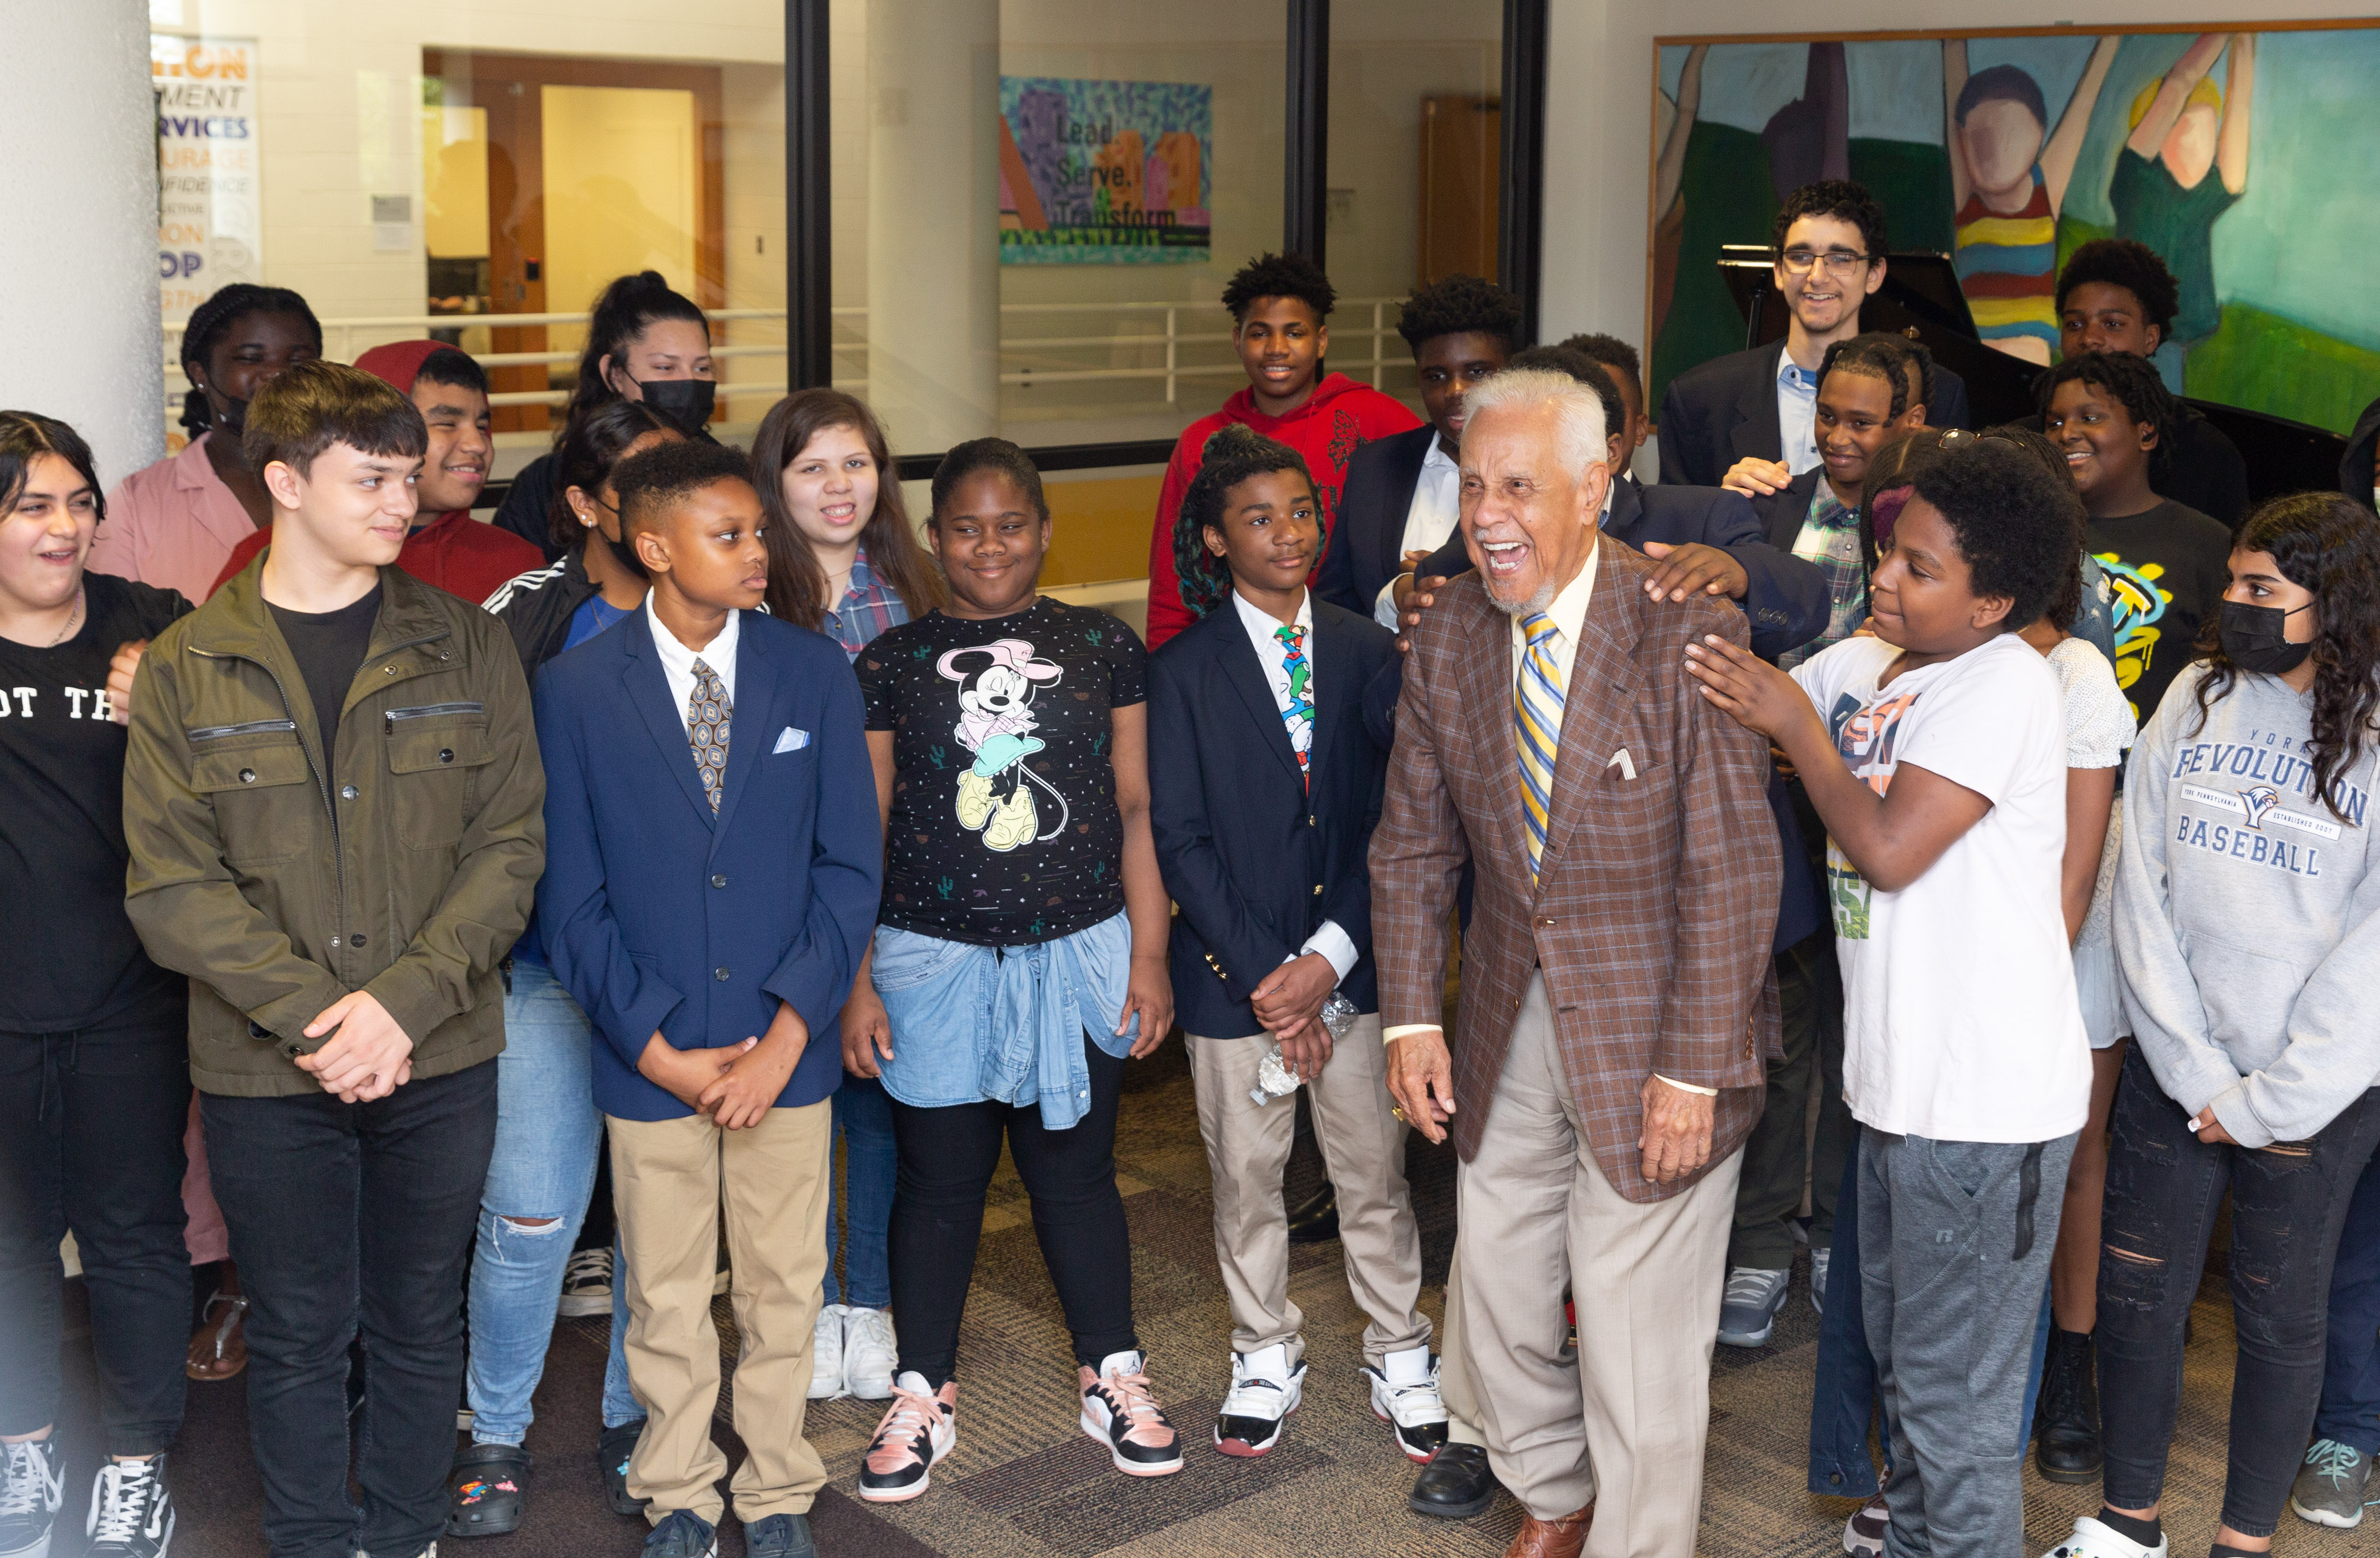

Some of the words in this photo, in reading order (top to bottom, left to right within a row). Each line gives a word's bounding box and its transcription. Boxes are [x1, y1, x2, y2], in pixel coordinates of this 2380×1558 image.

[2170, 743, 2370, 829] REVOLUTON
[2196, 792, 2237, 808] PENNSYLVANIA
[2273, 812, 2312, 828] ESTABLISHED
[2315, 824, 2333, 833] 2007
[2176, 815, 2320, 877] BASEBALL
